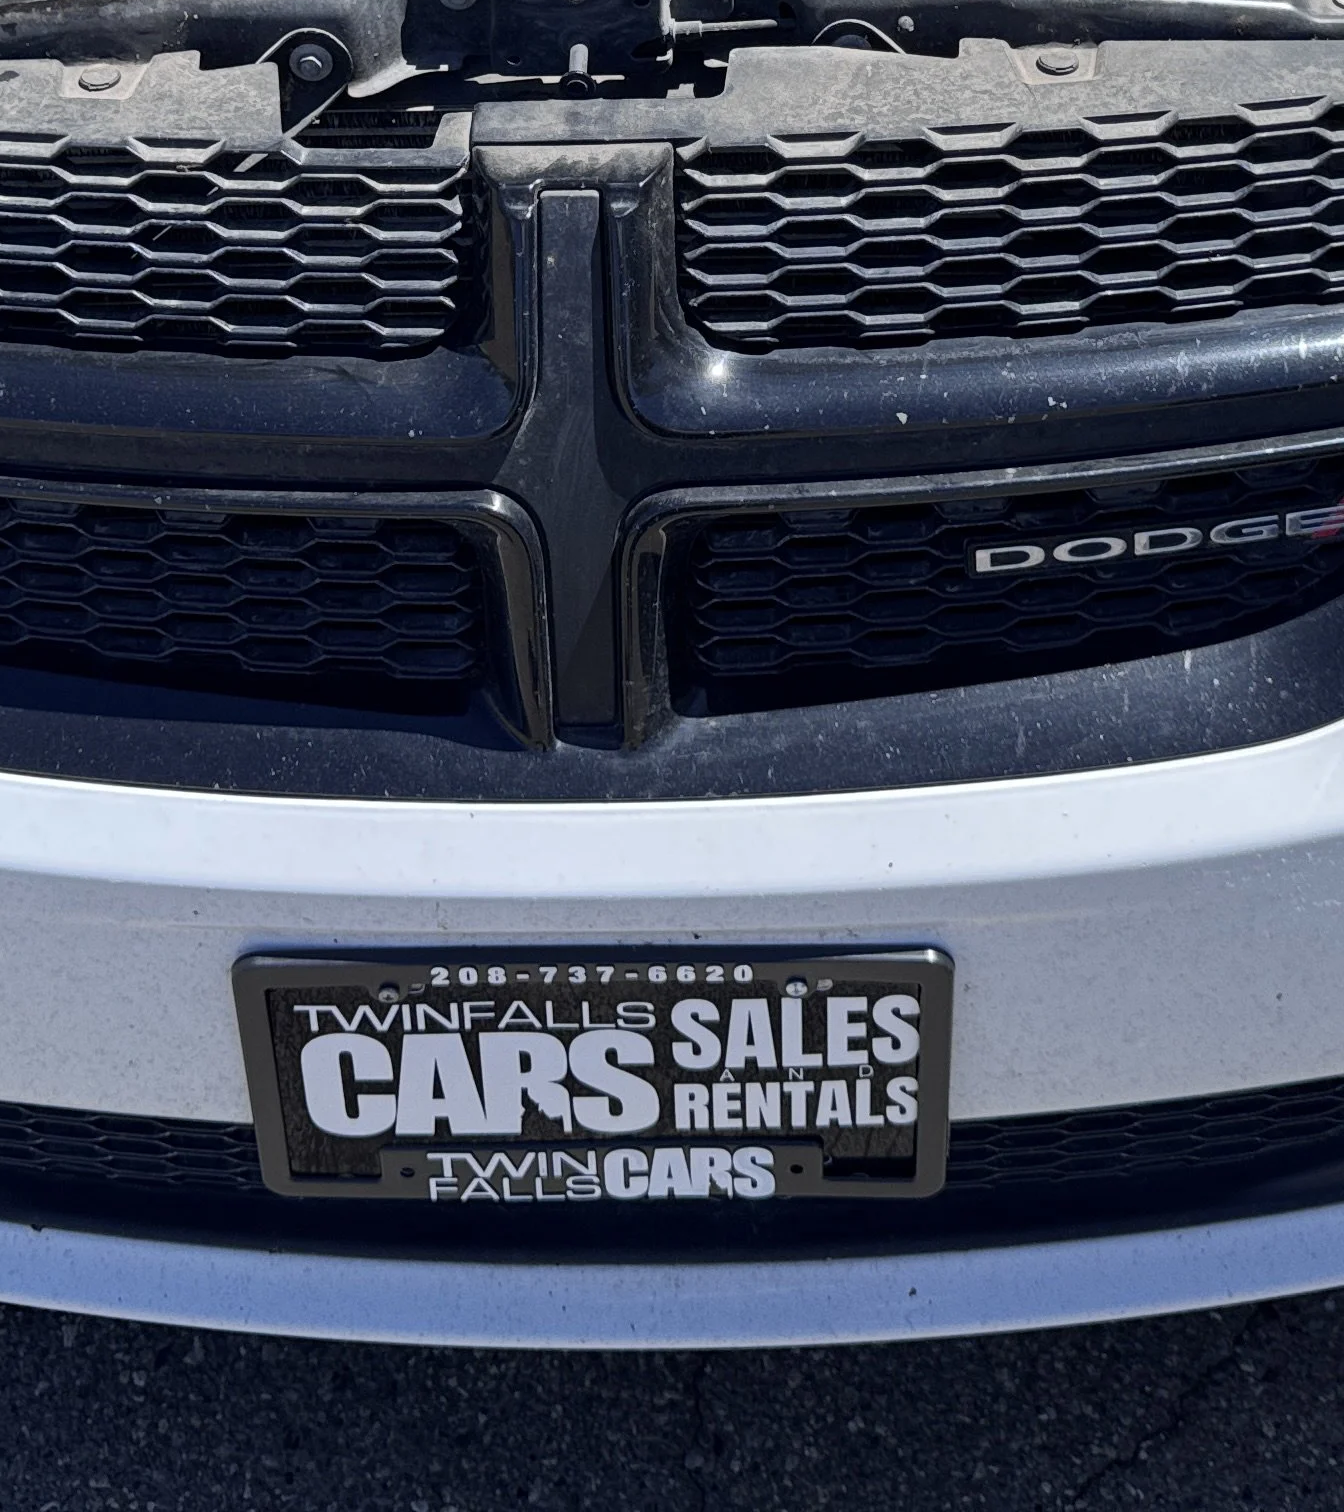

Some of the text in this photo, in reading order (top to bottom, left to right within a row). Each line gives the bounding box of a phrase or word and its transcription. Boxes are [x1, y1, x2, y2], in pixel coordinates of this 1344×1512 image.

[429, 963, 755, 988] 208-737-6620
[670, 994, 921, 1070] SALES
[300, 1028, 661, 1137] CARS
[673, 1075, 920, 1130] RENTALS
[426, 1150, 598, 1178] TWIN
[429, 1145, 776, 1203] FALLS CARS
